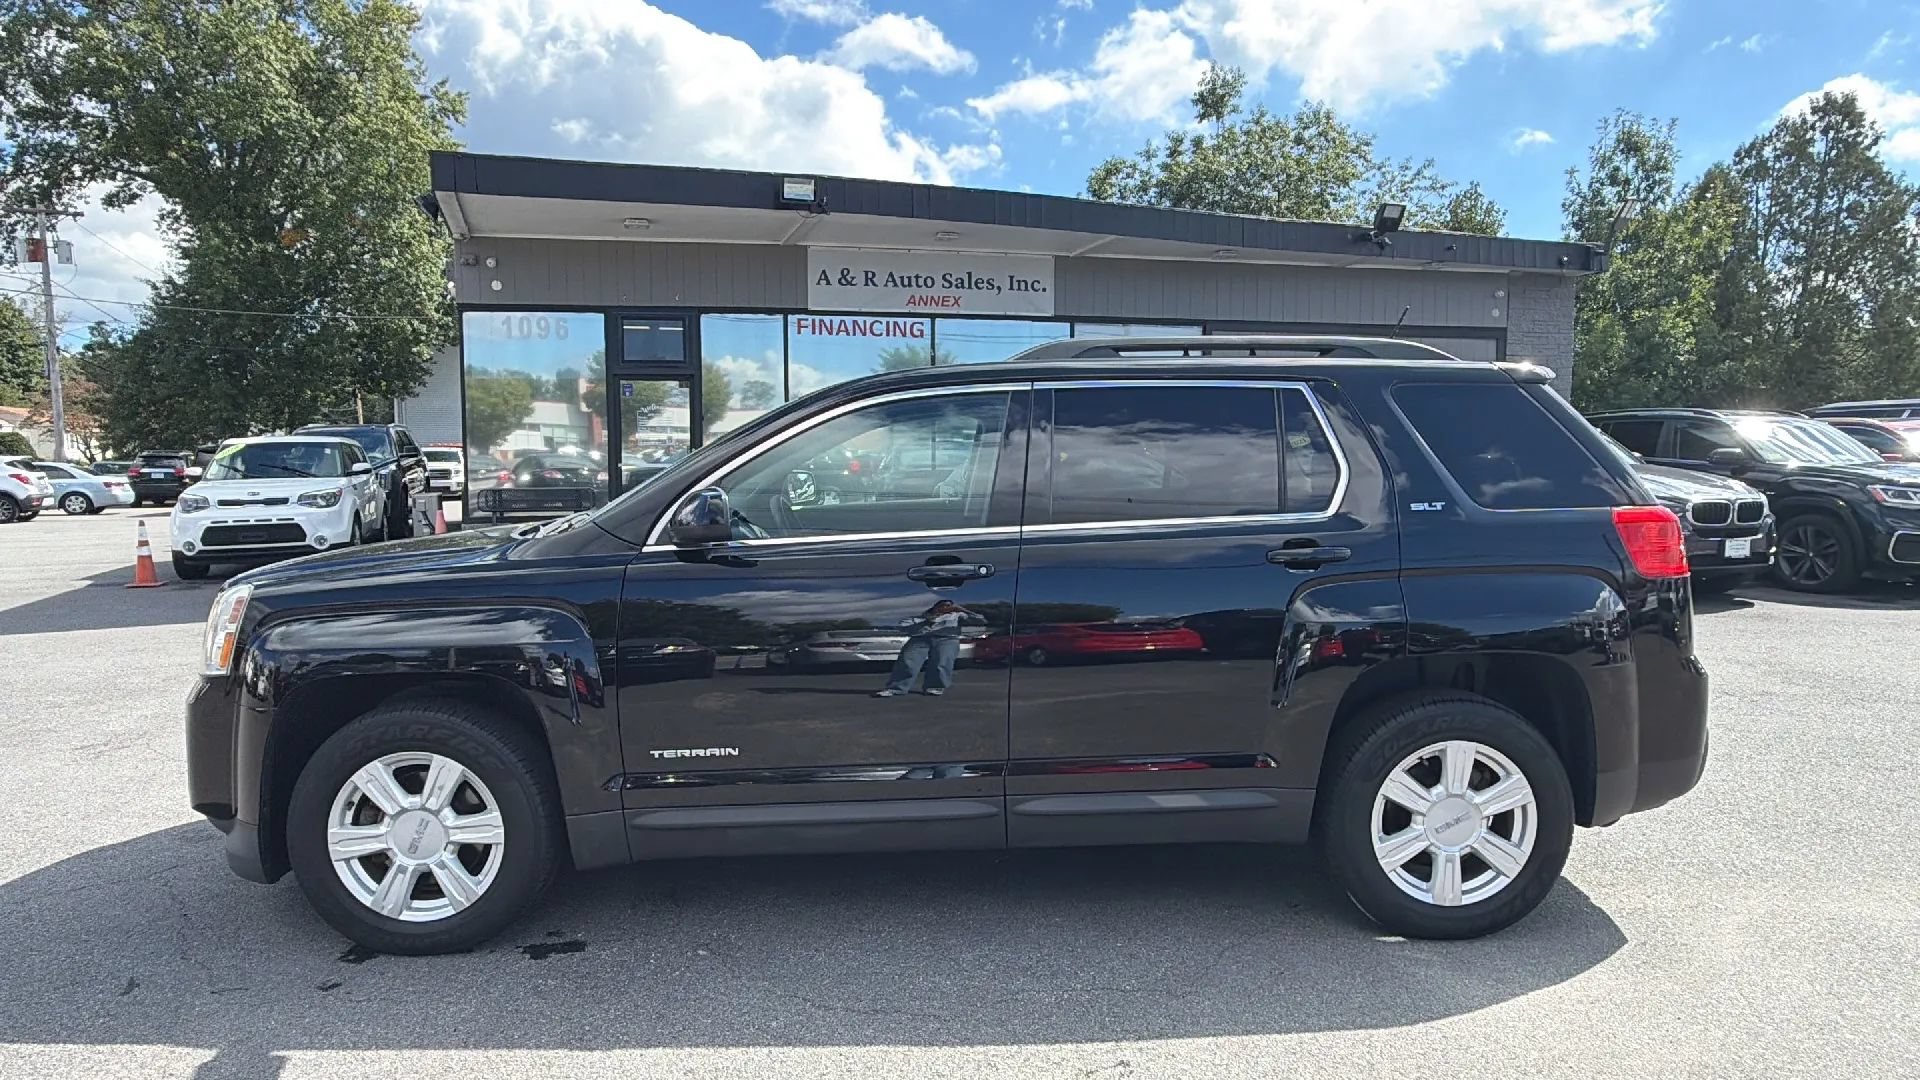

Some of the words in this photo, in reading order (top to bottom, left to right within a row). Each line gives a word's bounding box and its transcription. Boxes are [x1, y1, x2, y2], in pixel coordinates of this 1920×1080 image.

[815, 269, 832, 286] A
[837, 267, 858, 287] &
[863, 270, 879, 287] R
[883, 273, 936, 289] Auto
[941, 271, 1002, 296] Sales,
[1007, 275, 1048, 293] Inc.
[905, 294, 962, 308] ANNEX
[501, 315, 569, 340] 1096
[796, 317, 925, 339] FINANCING
[1410, 501, 1446, 511] SLT
[649, 747, 739, 759] TERRAIN
